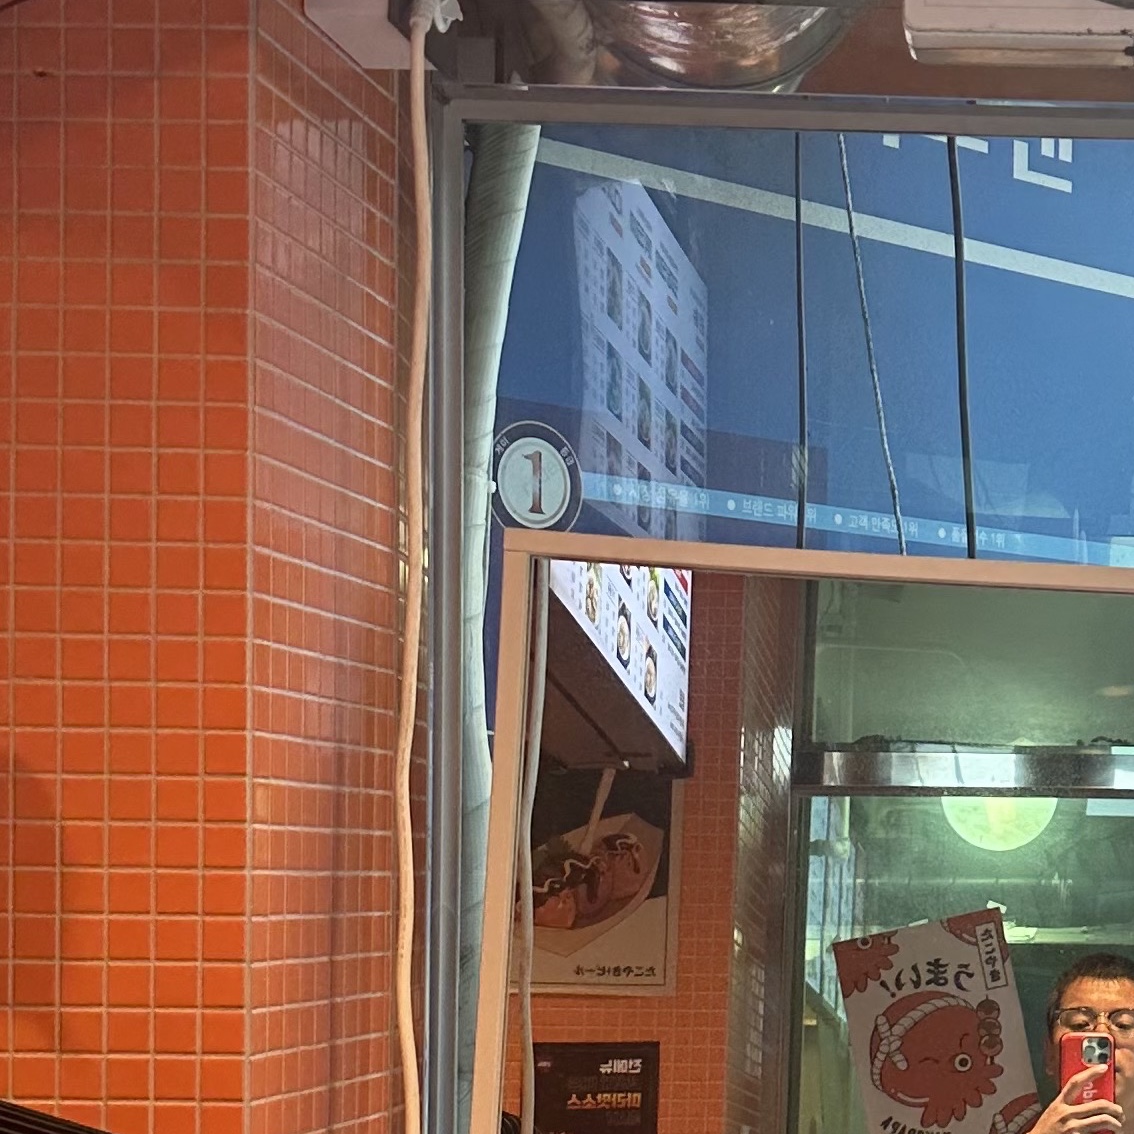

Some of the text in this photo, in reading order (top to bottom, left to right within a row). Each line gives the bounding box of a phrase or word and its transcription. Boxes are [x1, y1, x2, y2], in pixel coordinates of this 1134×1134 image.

[522, 450, 545, 515] 1
[742, 500, 774, 517] 브랜드
[848, 514, 868, 531] 고객
